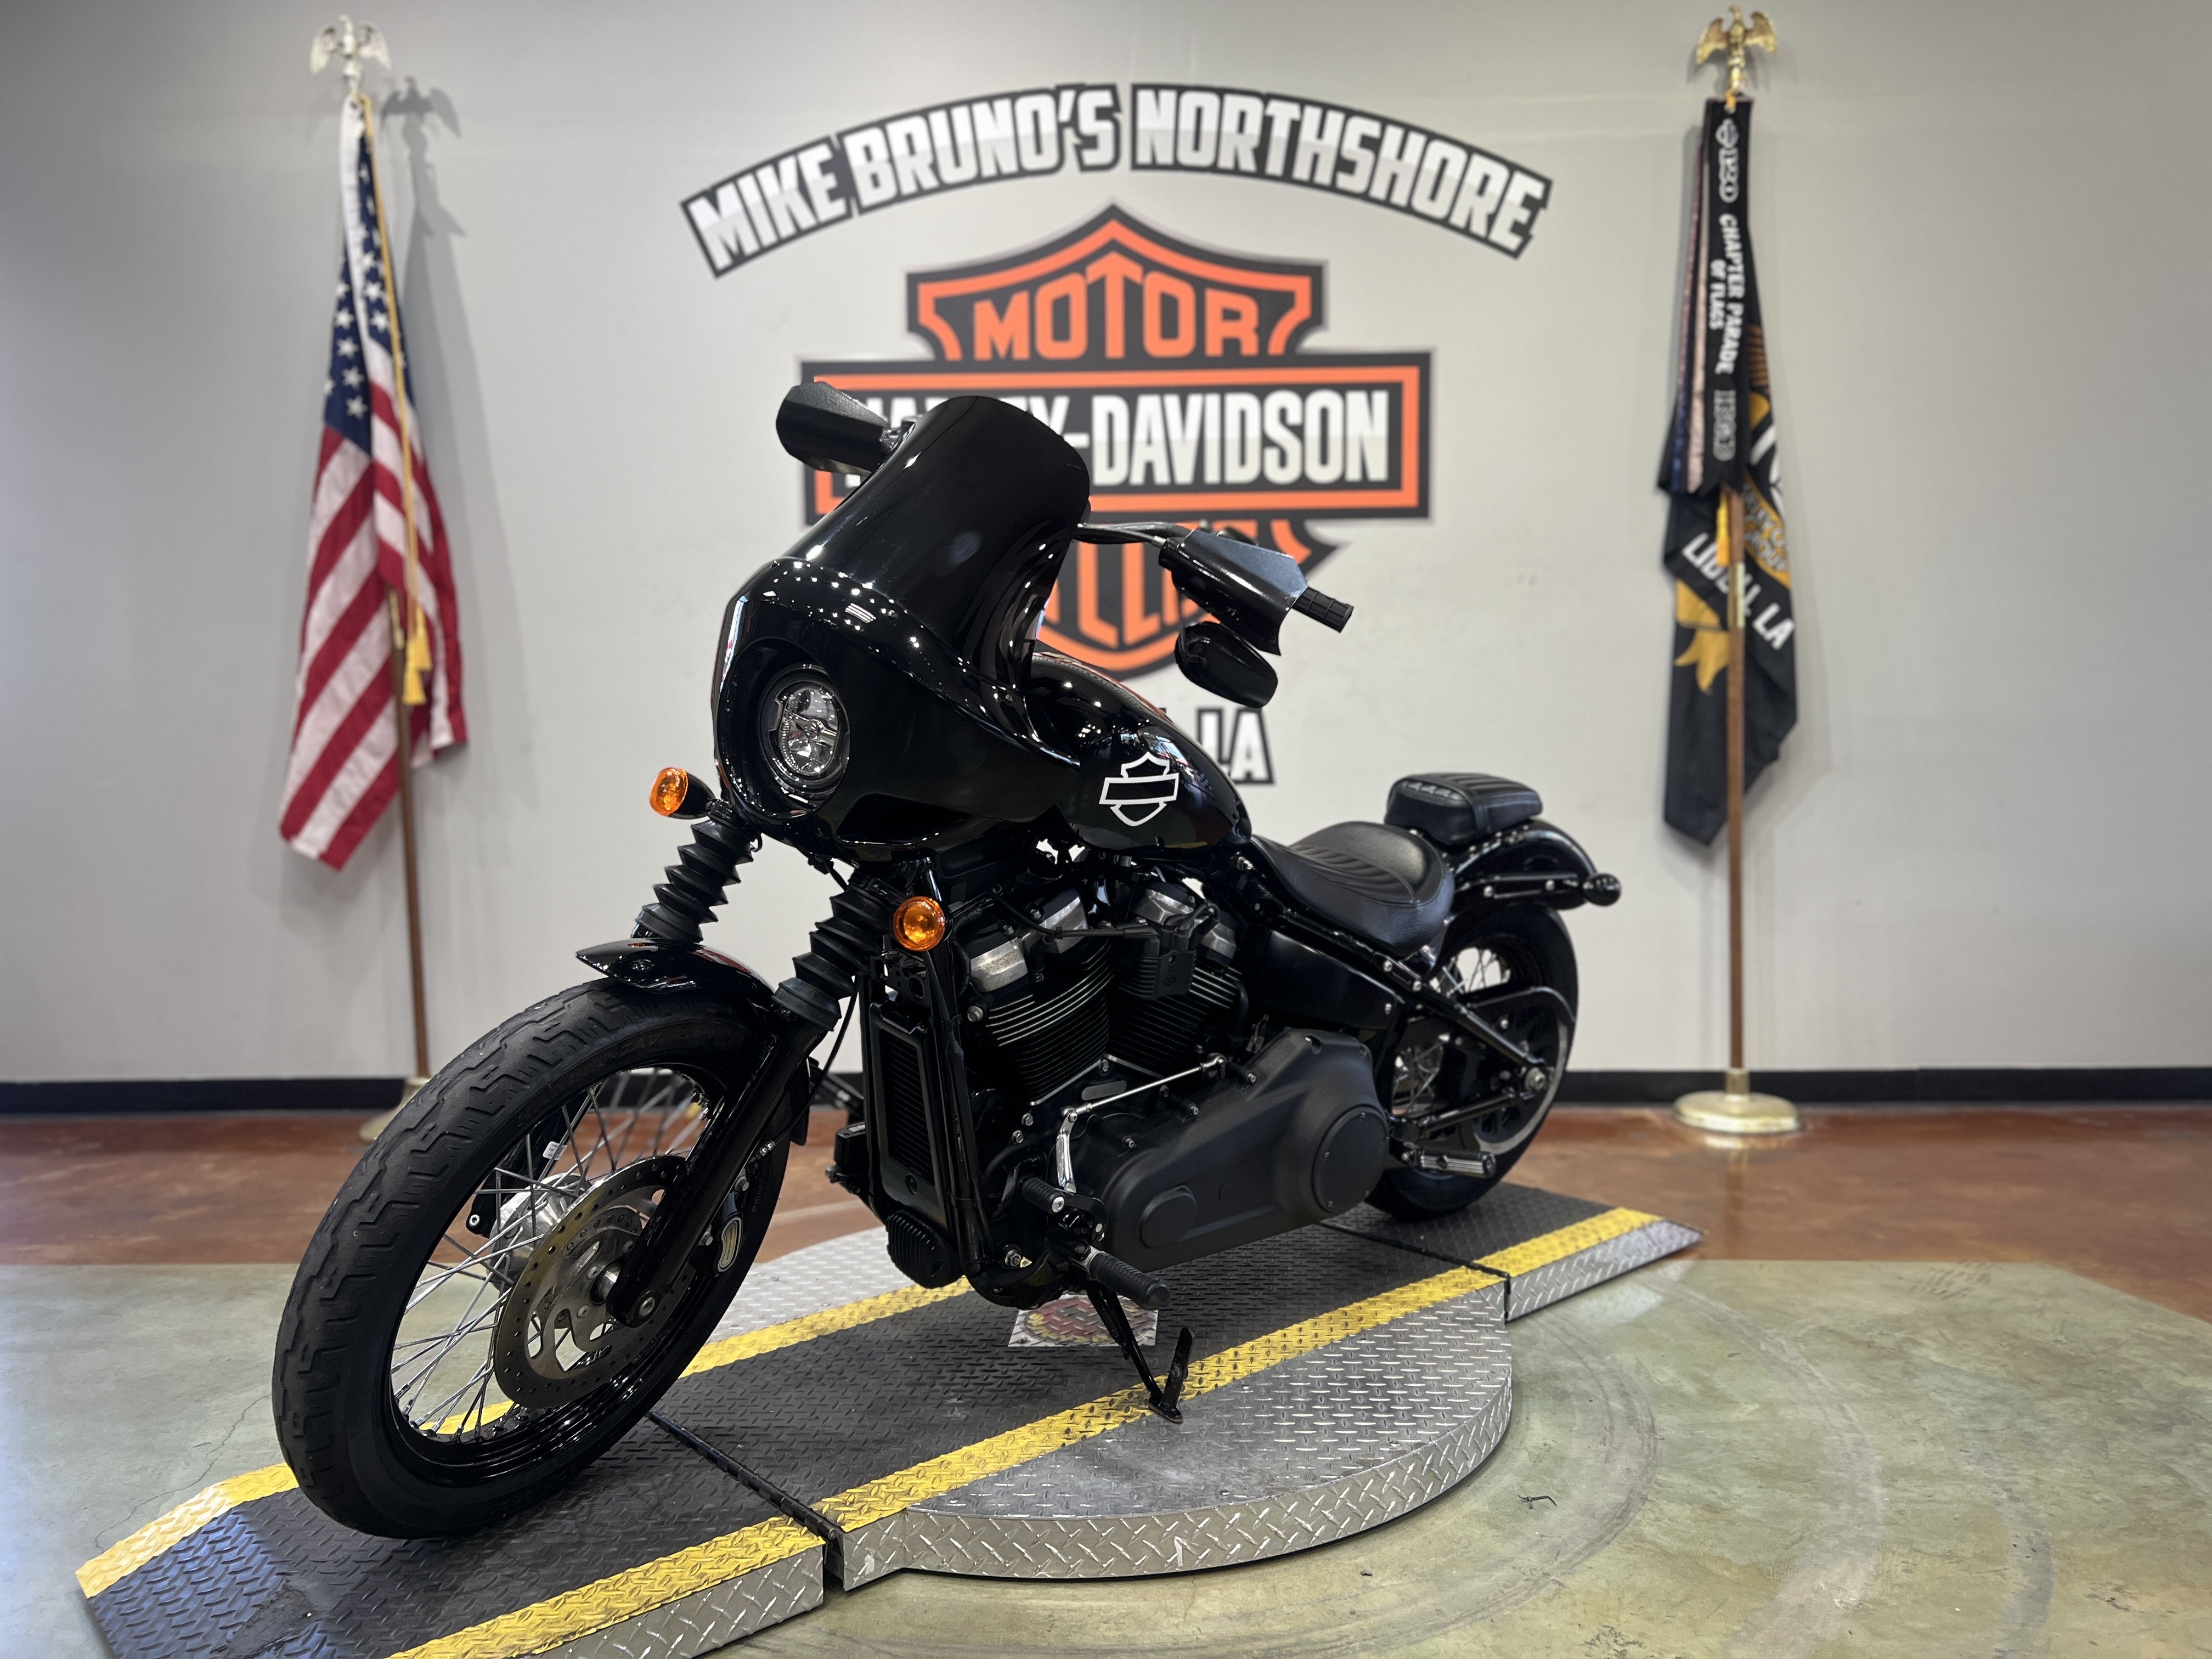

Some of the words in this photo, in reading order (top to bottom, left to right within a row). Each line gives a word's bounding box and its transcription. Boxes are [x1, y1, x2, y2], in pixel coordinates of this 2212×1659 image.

[685, 141, 850, 273] MIKE
[840, 88, 1117, 210] BRUNO'S
[1135, 88, 1546, 254] NORTHSHORE
[1718, 213, 1746, 300] CHAPTER
[973, 251, 1260, 361] MOTOR
[1708, 282, 1726, 330] FLAGS
[1714, 302, 1745, 375] PARADE
[845, 390, 1389, 488] Y-DAVIDSON
[1752, 602, 1795, 651] LA
